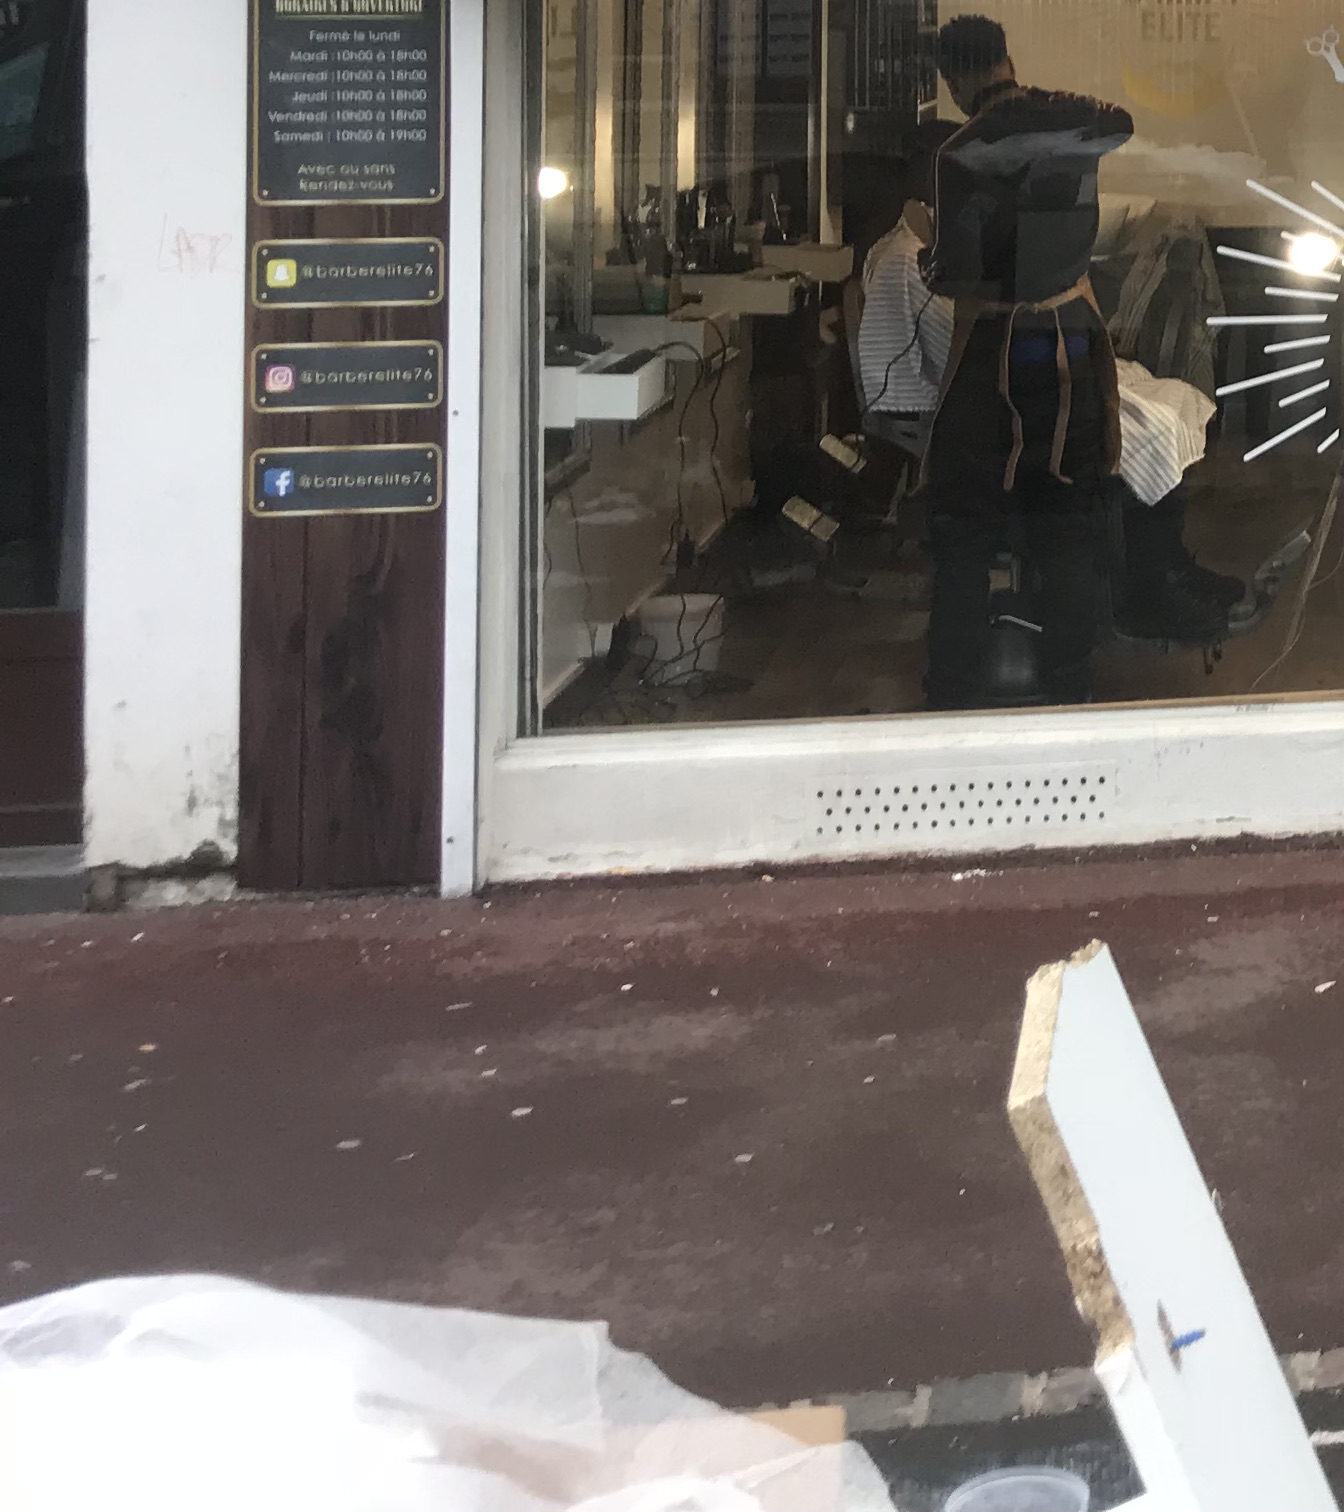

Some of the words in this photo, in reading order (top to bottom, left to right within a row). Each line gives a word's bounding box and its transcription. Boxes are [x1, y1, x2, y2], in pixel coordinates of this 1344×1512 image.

[302, 263, 433, 279] @barberelite76
[300, 367, 433, 384] @barberelite76
[299, 472, 432, 489] @barberelite76
